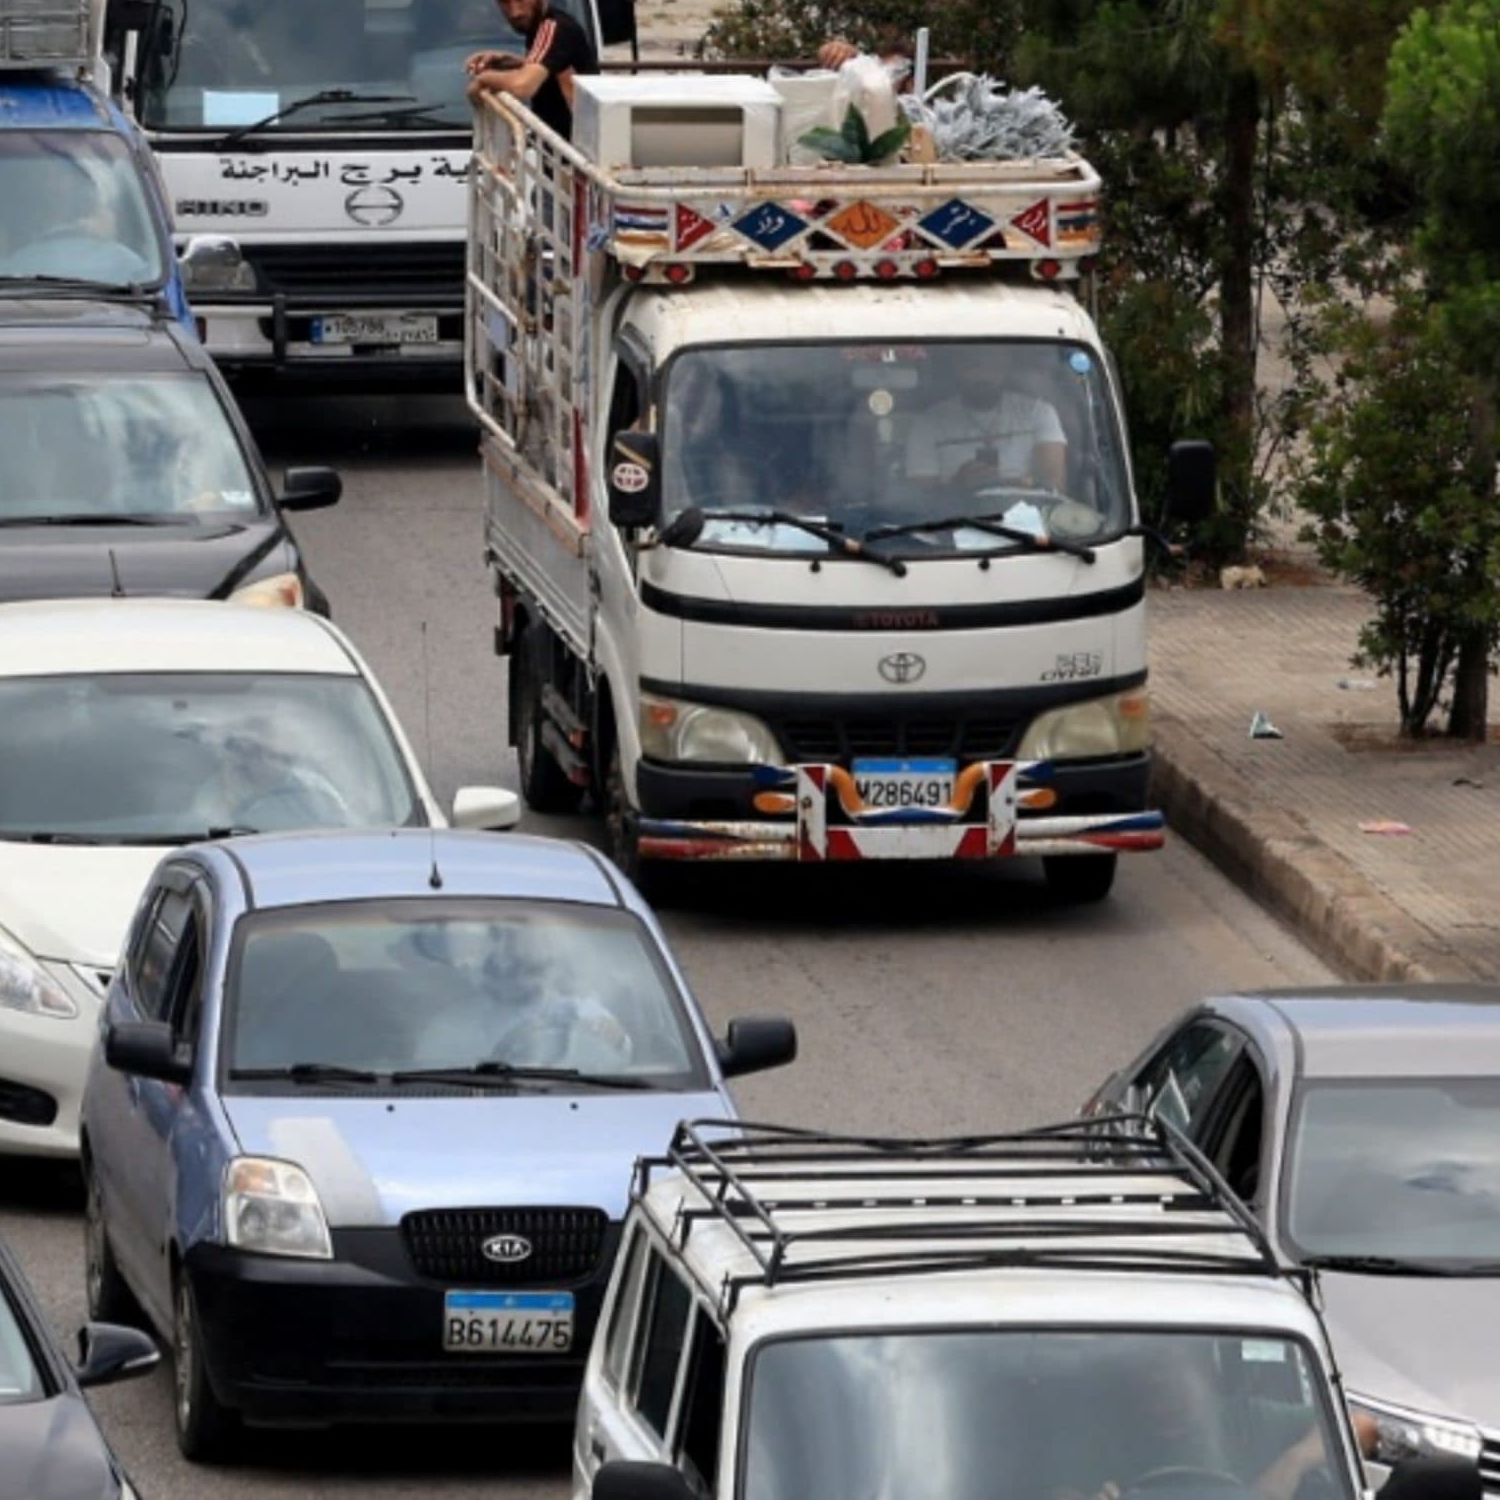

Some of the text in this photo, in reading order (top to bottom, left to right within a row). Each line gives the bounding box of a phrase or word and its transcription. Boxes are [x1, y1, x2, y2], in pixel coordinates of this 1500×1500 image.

[220, 159, 330, 186] البراجنة
[339, 160, 424, 186] برج
[491, 1242, 524, 1255] KIA
[448, 1318, 570, 1348] B614475
